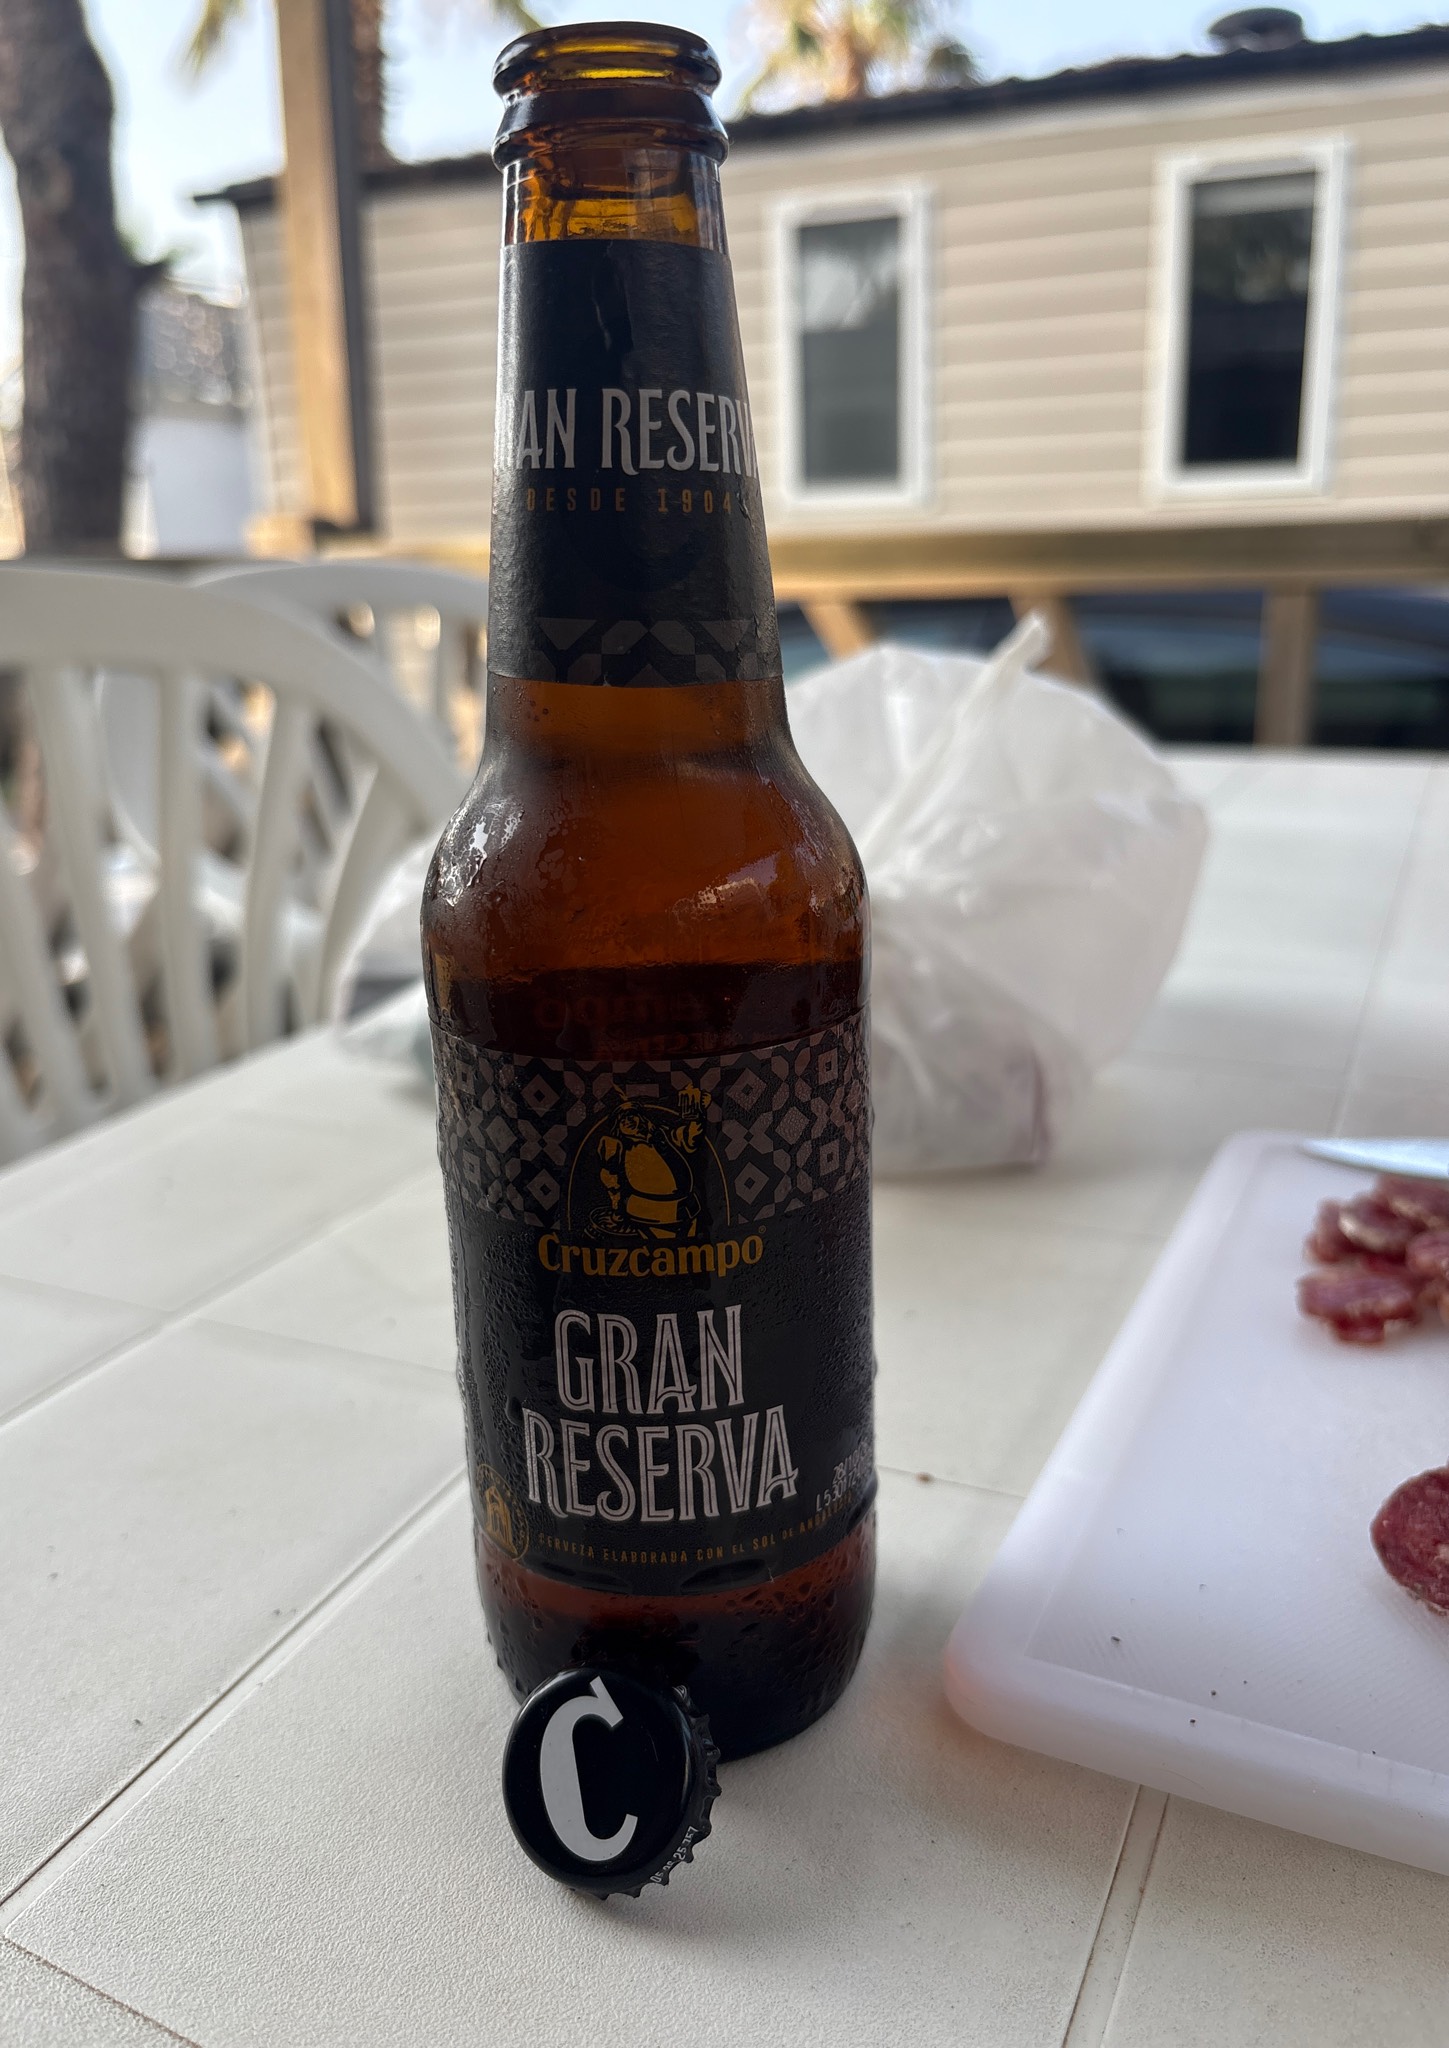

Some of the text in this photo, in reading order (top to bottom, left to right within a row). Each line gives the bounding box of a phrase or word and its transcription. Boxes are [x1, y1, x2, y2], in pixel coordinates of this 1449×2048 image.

[511, 387, 577, 469] AN
[527, 487, 732, 514] DESDE 1904
[537, 1232, 764, 1278] Cruzcampo
[554, 1304, 745, 1414] GRAN
[522, 1405, 799, 1522] RESERVA
[538, 1532, 595, 1560] CERVEZA
[603, 1548, 688, 1564] ELABORADA
[696, 1546, 724, 1562] CON
[733, 1544, 745, 1555] EL
[753, 1533, 776, 1551] SOL
[782, 1529, 794, 1540] DE
[540, 1675, 639, 1862] C
